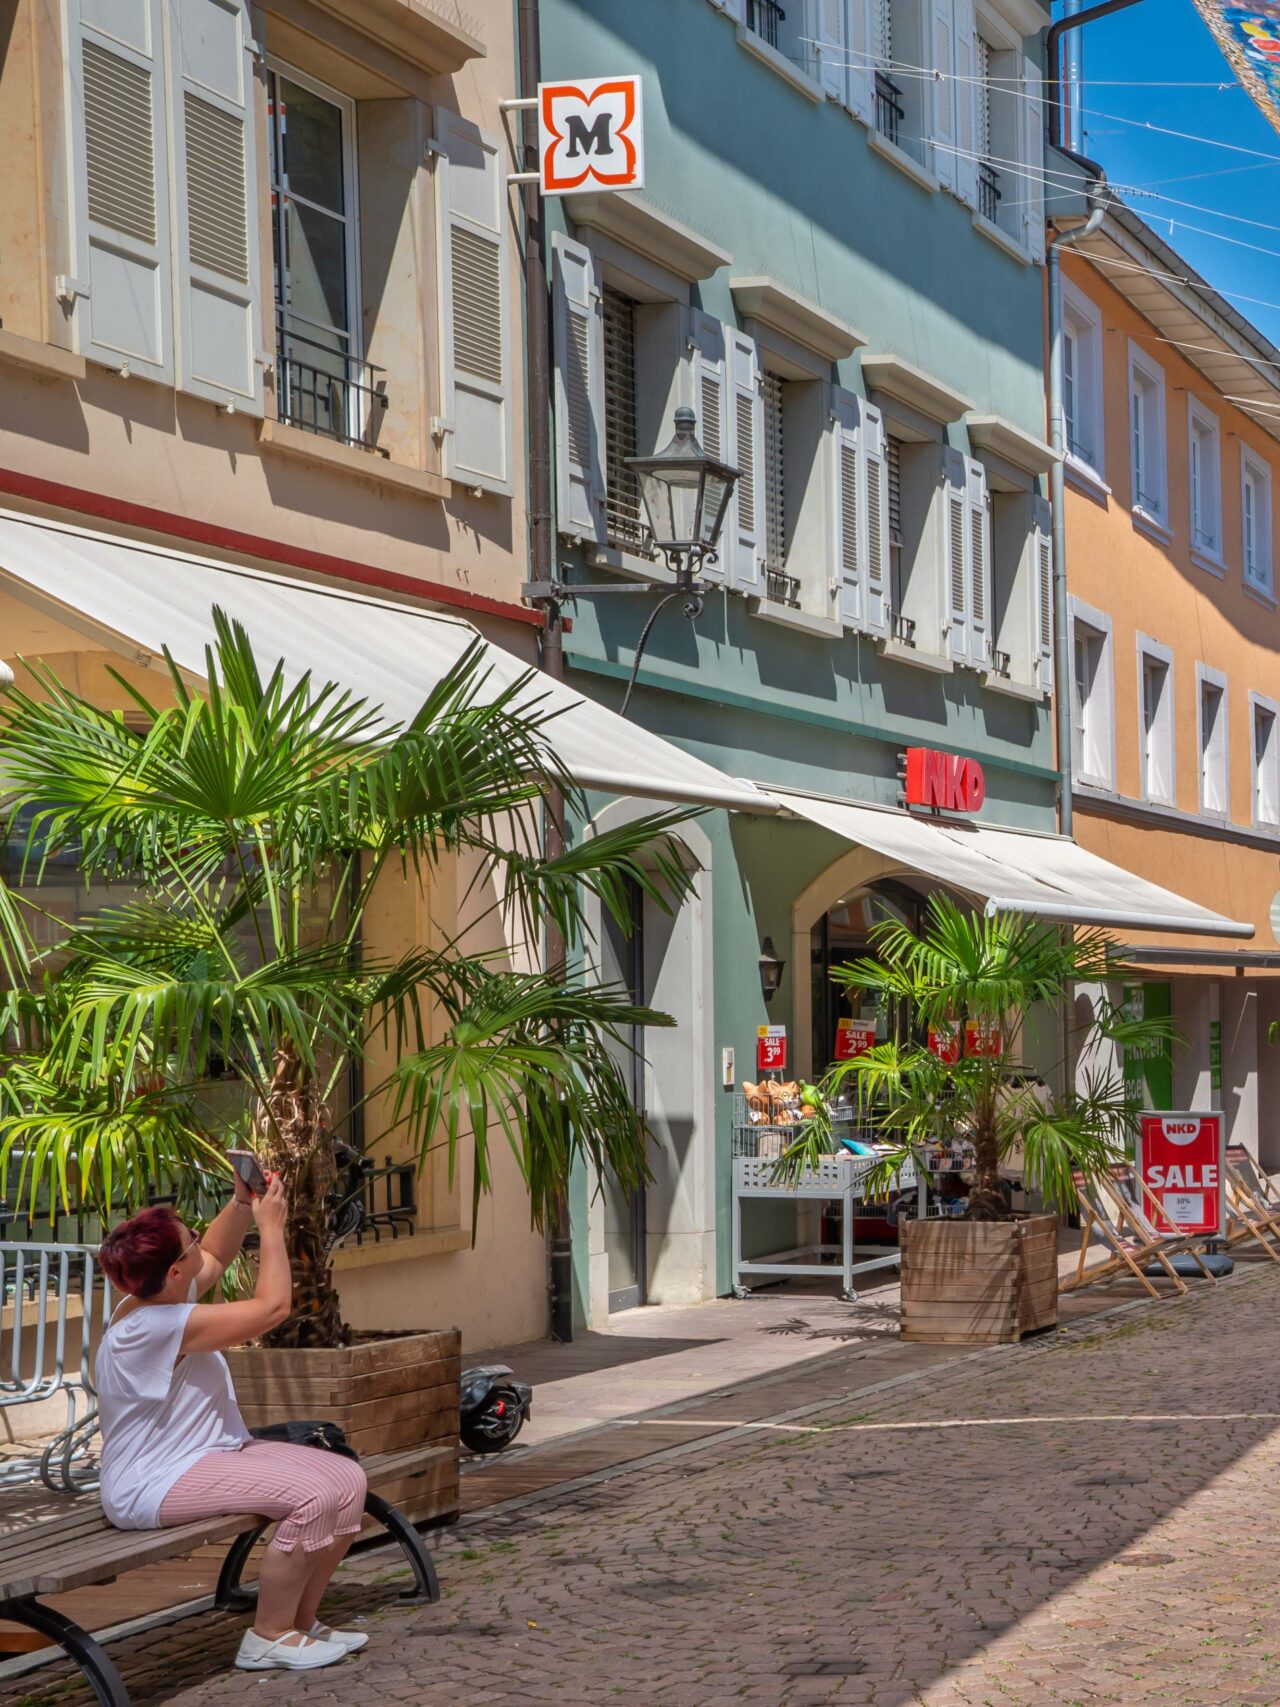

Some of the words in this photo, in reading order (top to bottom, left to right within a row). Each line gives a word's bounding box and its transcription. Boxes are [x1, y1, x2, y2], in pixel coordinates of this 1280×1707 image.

[564, 112, 614, 158] M
[922, 747, 985, 814] NKD
[764, 1037, 781, 1046] SALE
[845, 1030, 867, 1040] SALE
[1166, 1123, 1197, 1135] NKD
[1147, 1164, 1218, 1188] SALE
